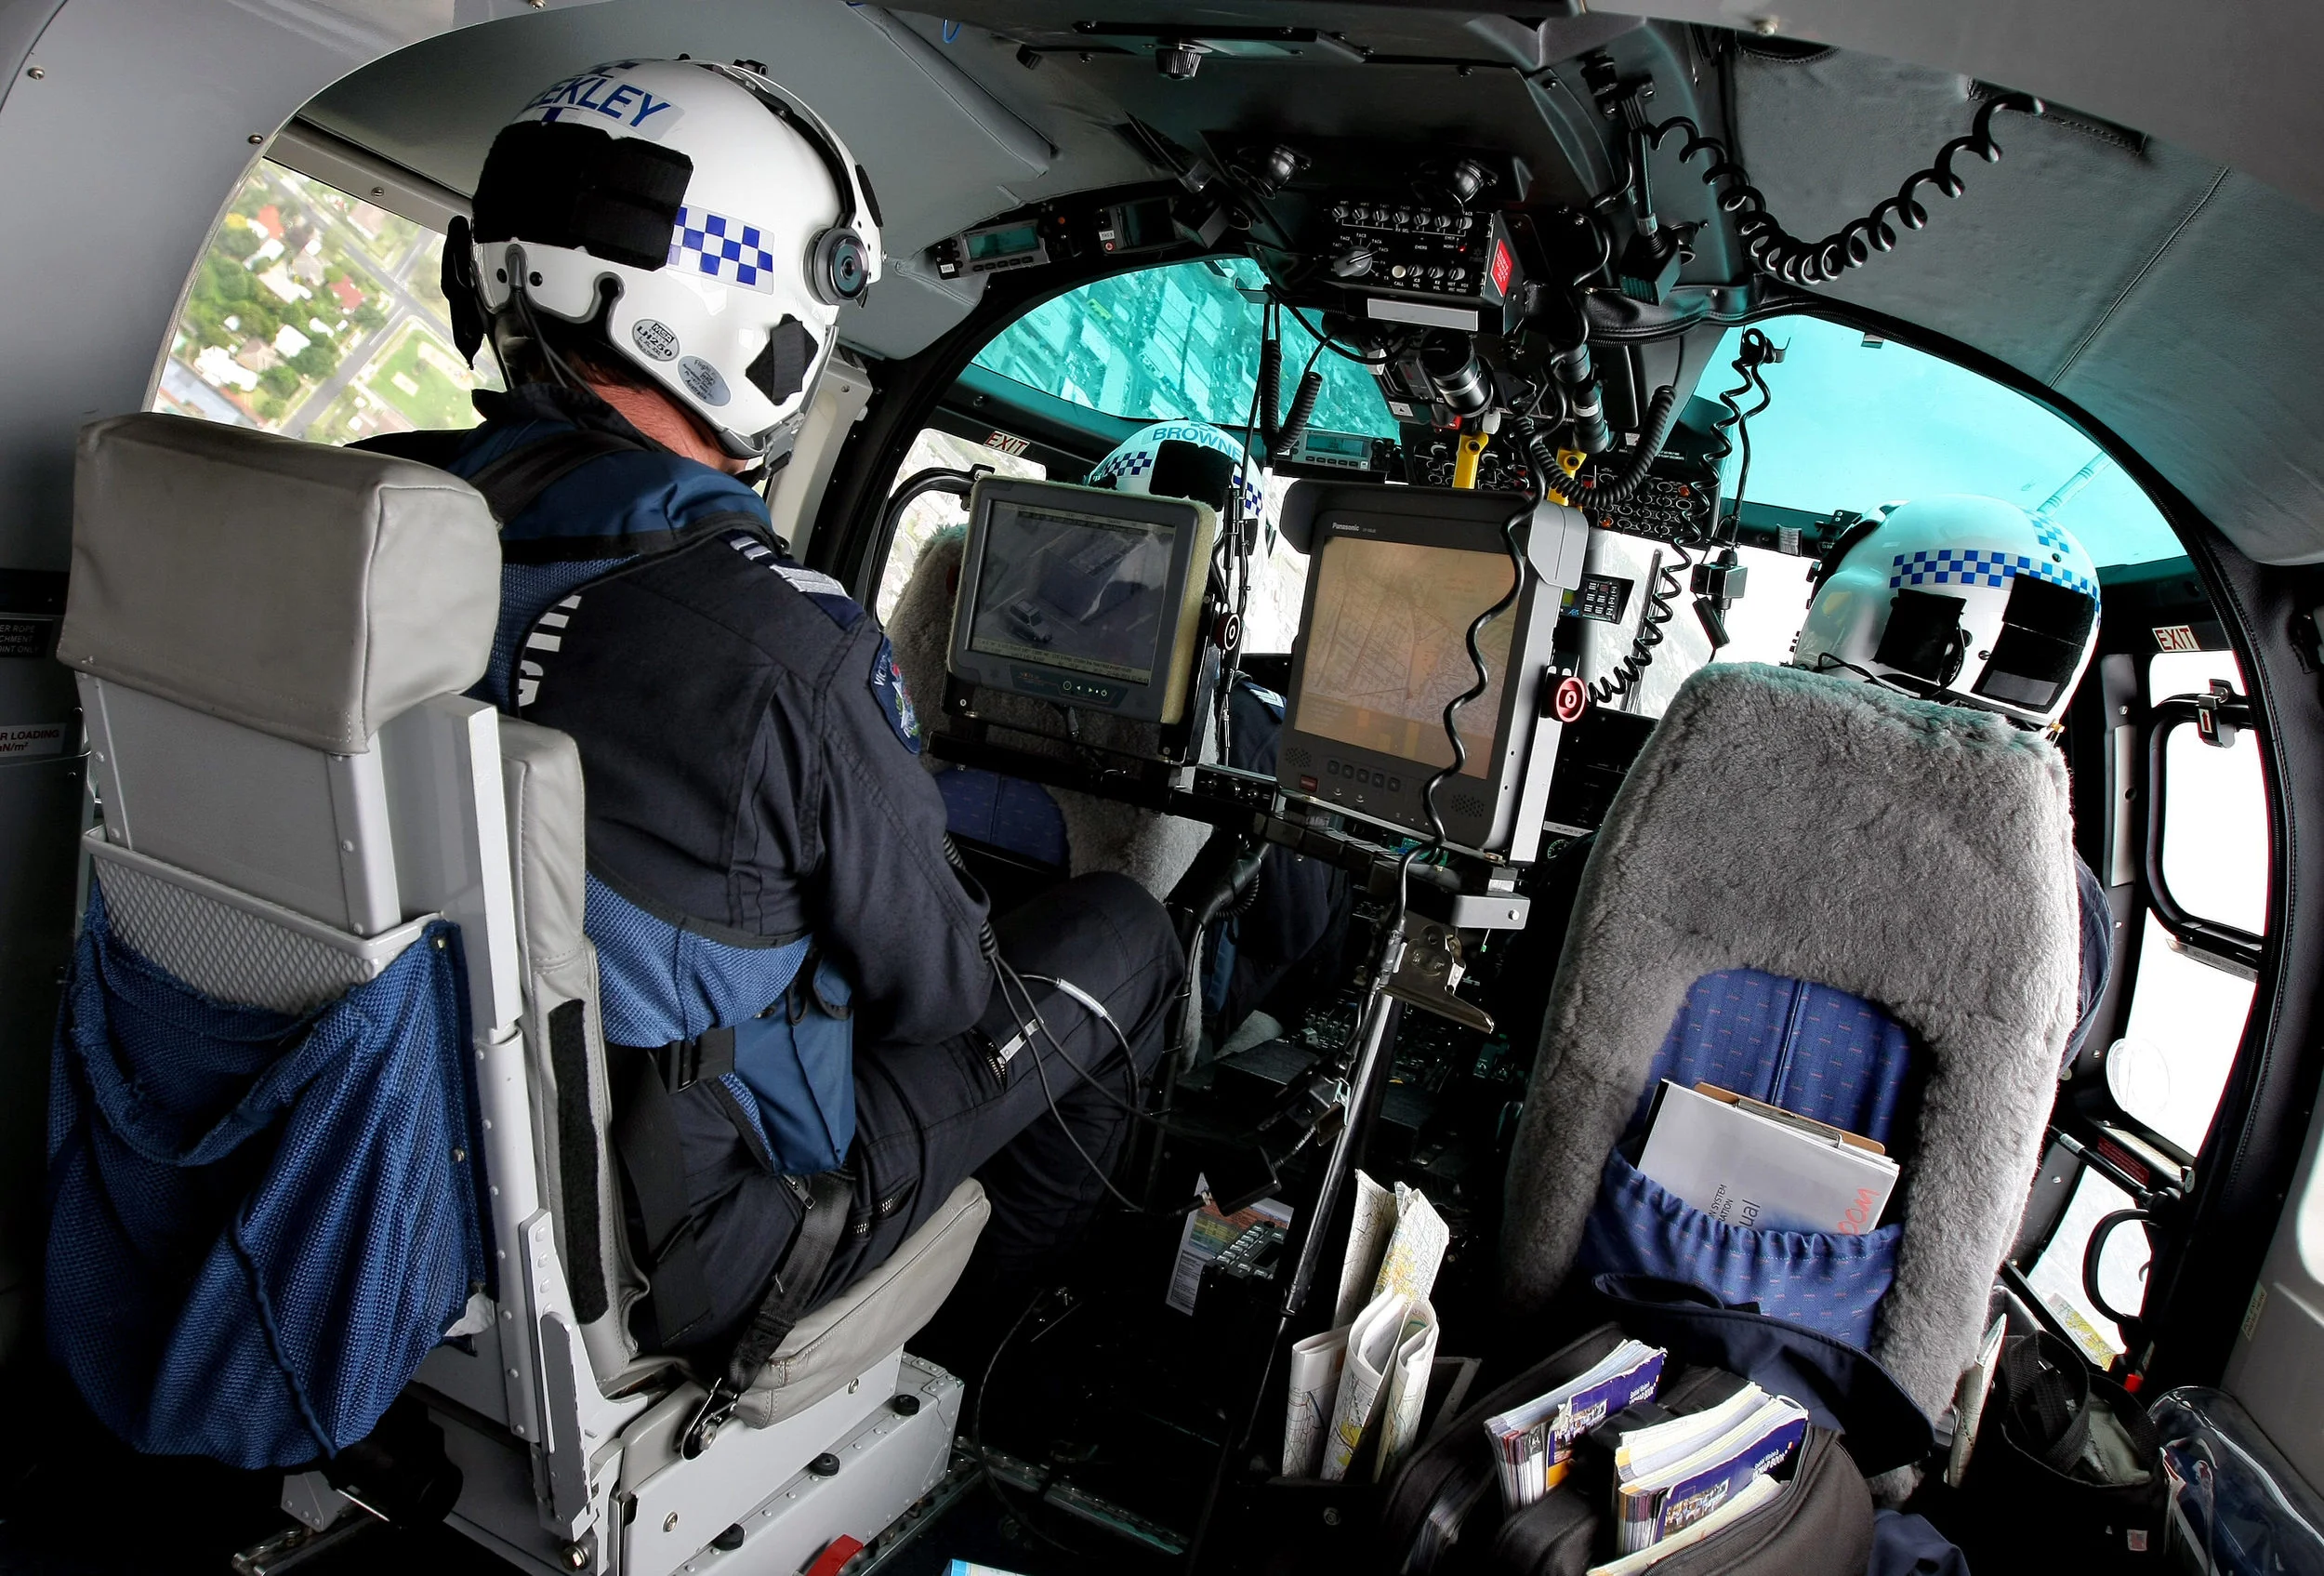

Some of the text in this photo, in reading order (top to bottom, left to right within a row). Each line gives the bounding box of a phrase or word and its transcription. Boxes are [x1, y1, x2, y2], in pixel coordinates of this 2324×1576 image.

[653, 324, 674, 342] MSA
[985, 431, 1029, 455] EXIT
[1332, 522, 1359, 531] Panasonic
[13, 625, 36, 634] ROPE
[2155, 628, 2195, 650] EXIT
[11, 730, 59, 741] LOADING
[1711, 1184, 1727, 1211] SYSTEM
[1738, 1199, 1761, 1227] ual
